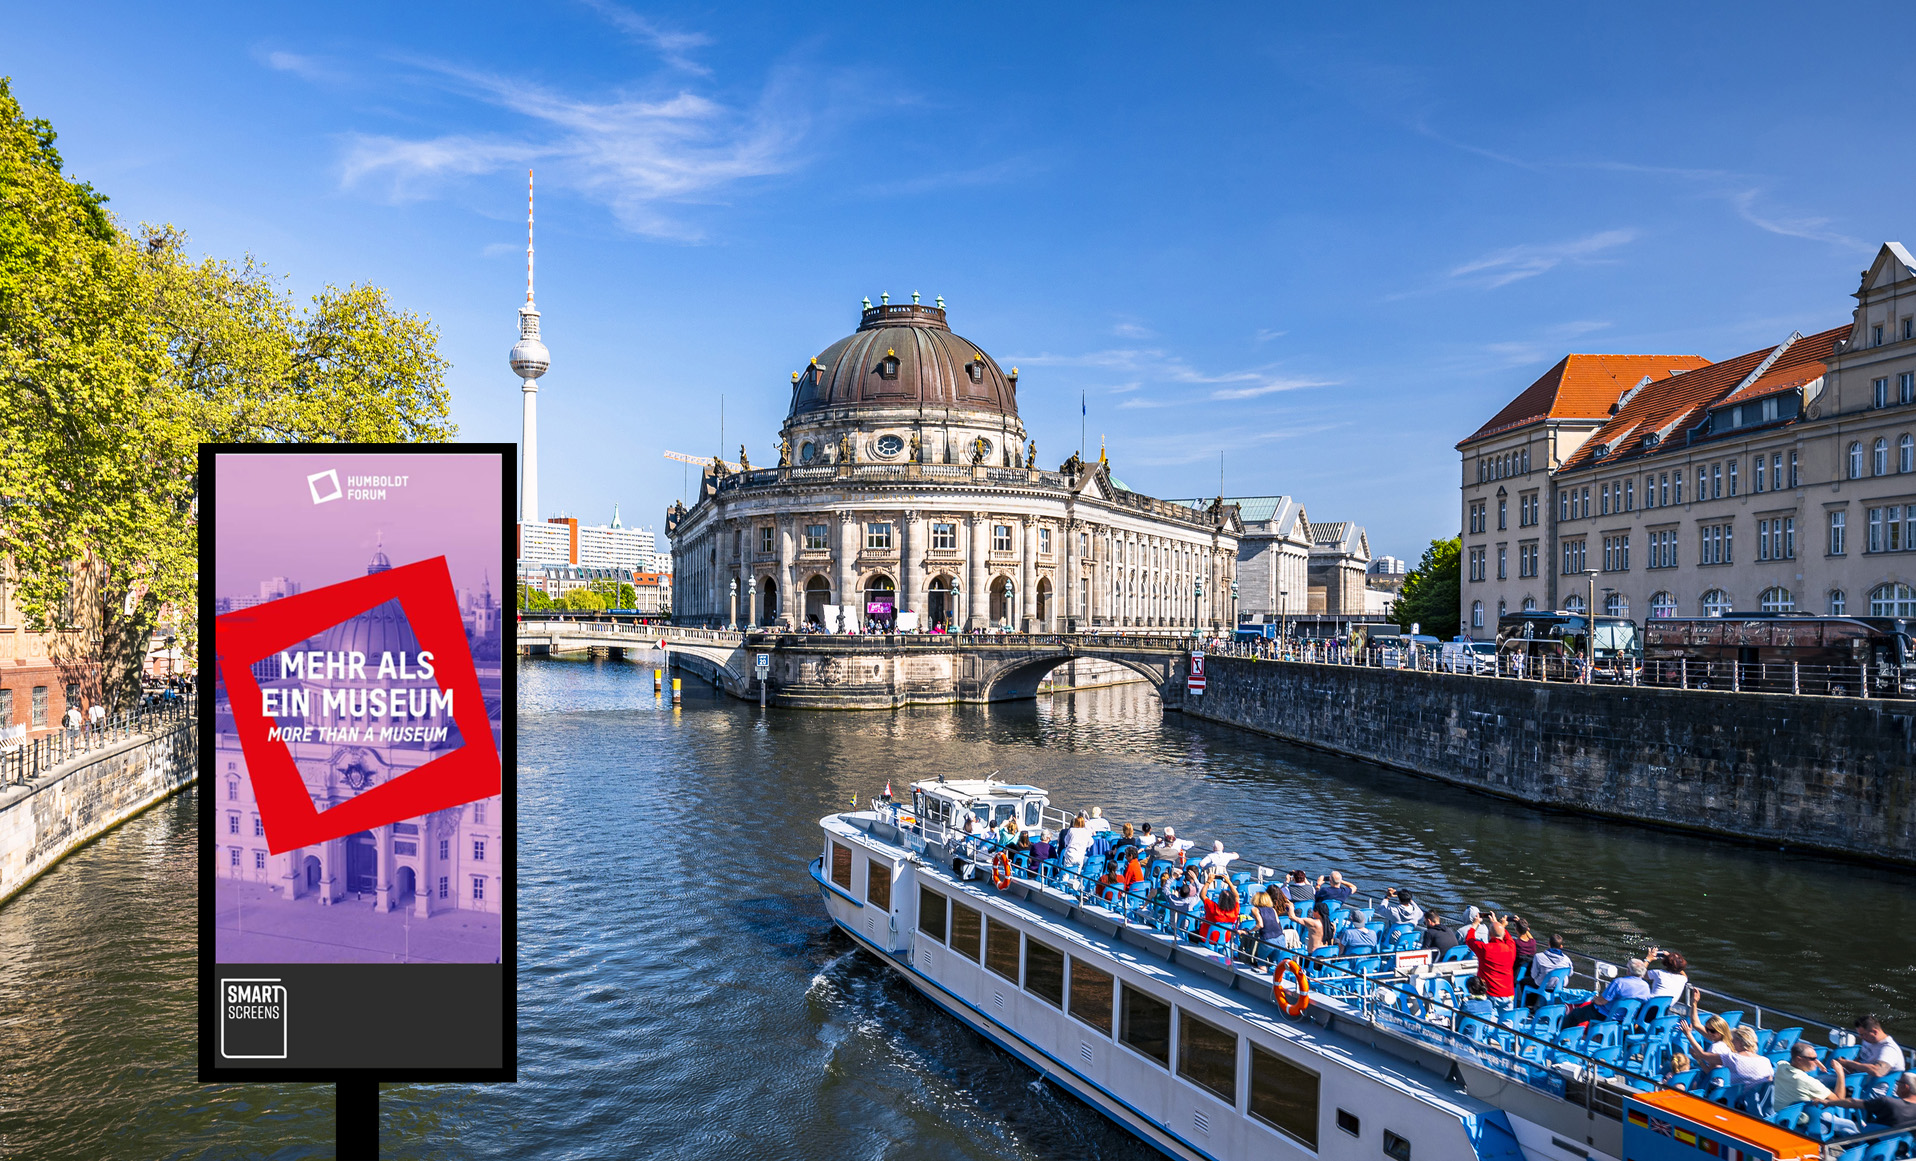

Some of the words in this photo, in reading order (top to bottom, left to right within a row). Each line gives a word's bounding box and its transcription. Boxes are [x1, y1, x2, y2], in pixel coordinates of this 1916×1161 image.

[347, 475, 409, 487] HUMBOLDT
[347, 489, 386, 500] FORUM
[281, 651, 366, 680] MEHR
[377, 651, 435, 680] ALS
[262, 688, 310, 717] EIN
[322, 688, 454, 717] MUSEUM
[267, 726, 313, 742] MORE
[318, 726, 360, 742] THAN
[363, 726, 375, 742] A
[379, 726, 448, 742] MUSEUM
[228, 985, 280, 1004] SMART
[228, 1005, 280, 1020] SCREENS
[1404, 1020, 1422, 1033] Kraft
